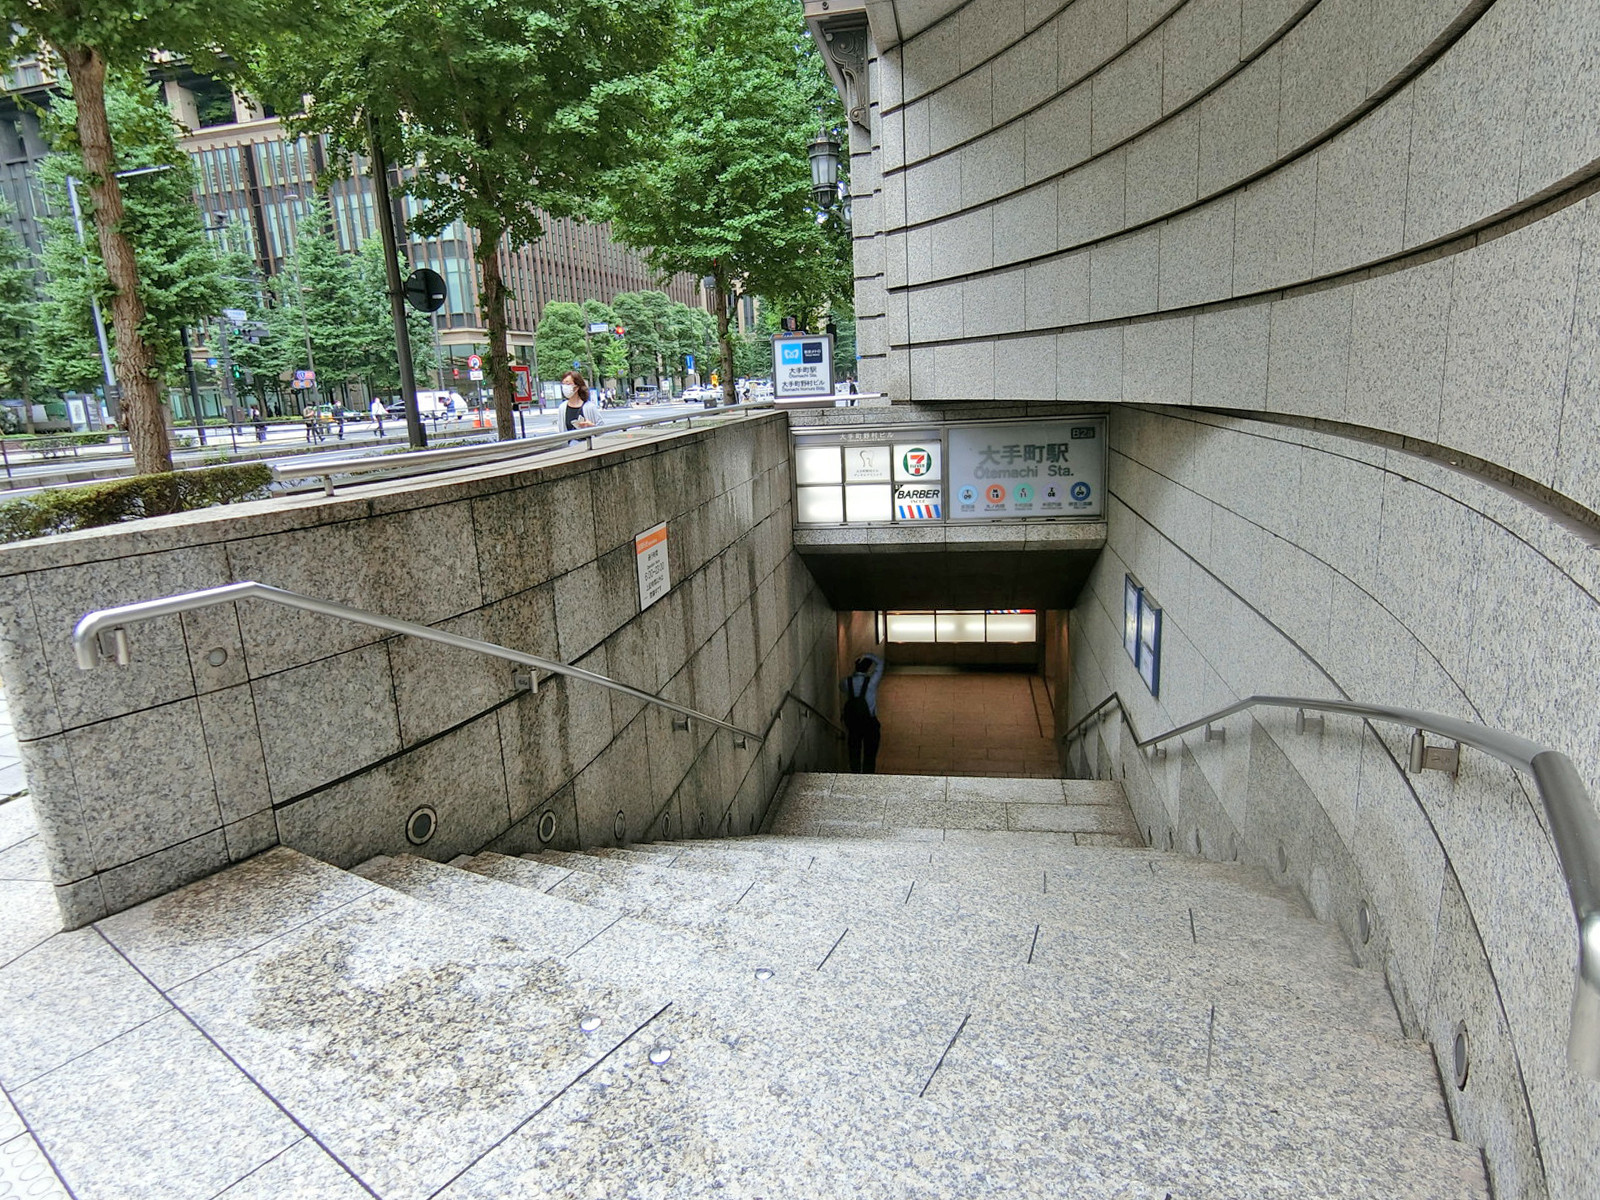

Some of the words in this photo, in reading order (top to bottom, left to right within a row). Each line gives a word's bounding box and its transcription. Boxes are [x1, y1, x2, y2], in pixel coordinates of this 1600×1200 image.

[839, 432, 895, 440] 大手町野村ビル
[978, 443, 1069, 465] 大手町駅
[1047, 465, 1074, 477] Sta.
[897, 489, 940, 499] BARBER
